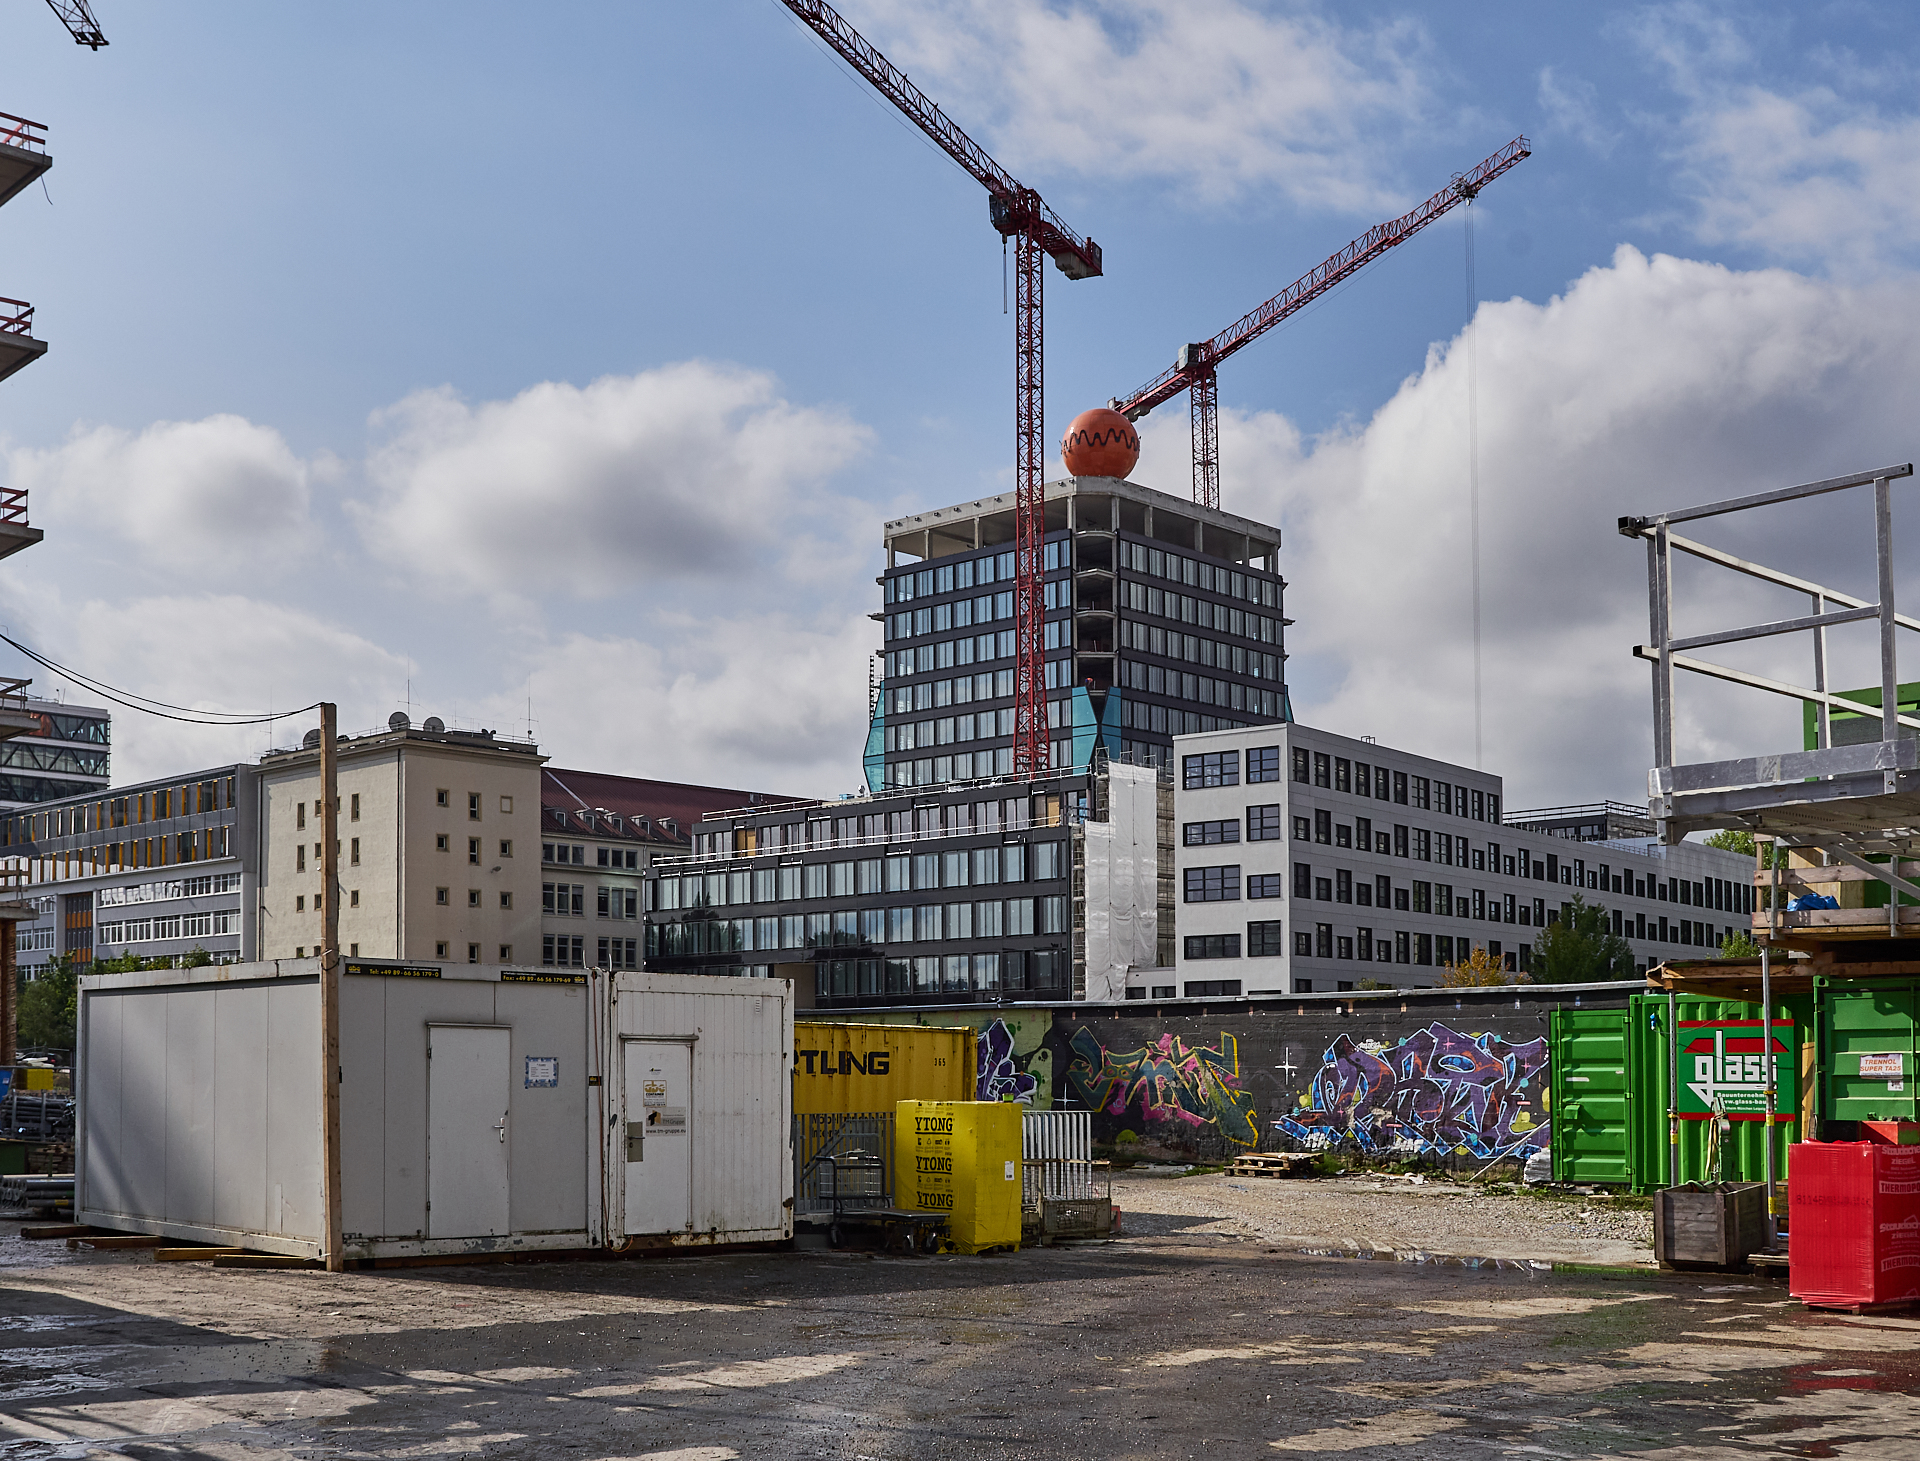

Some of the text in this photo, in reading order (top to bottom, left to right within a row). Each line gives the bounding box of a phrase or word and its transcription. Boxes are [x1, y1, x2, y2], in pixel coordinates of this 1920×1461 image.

[794, 1050, 890, 1076] TLING
[934, 1057, 946, 1067] 365
[915, 1117, 953, 1132] YTONG
[915, 1156, 952, 1172] YTONG
[916, 1191, 954, 1207] YTONG
